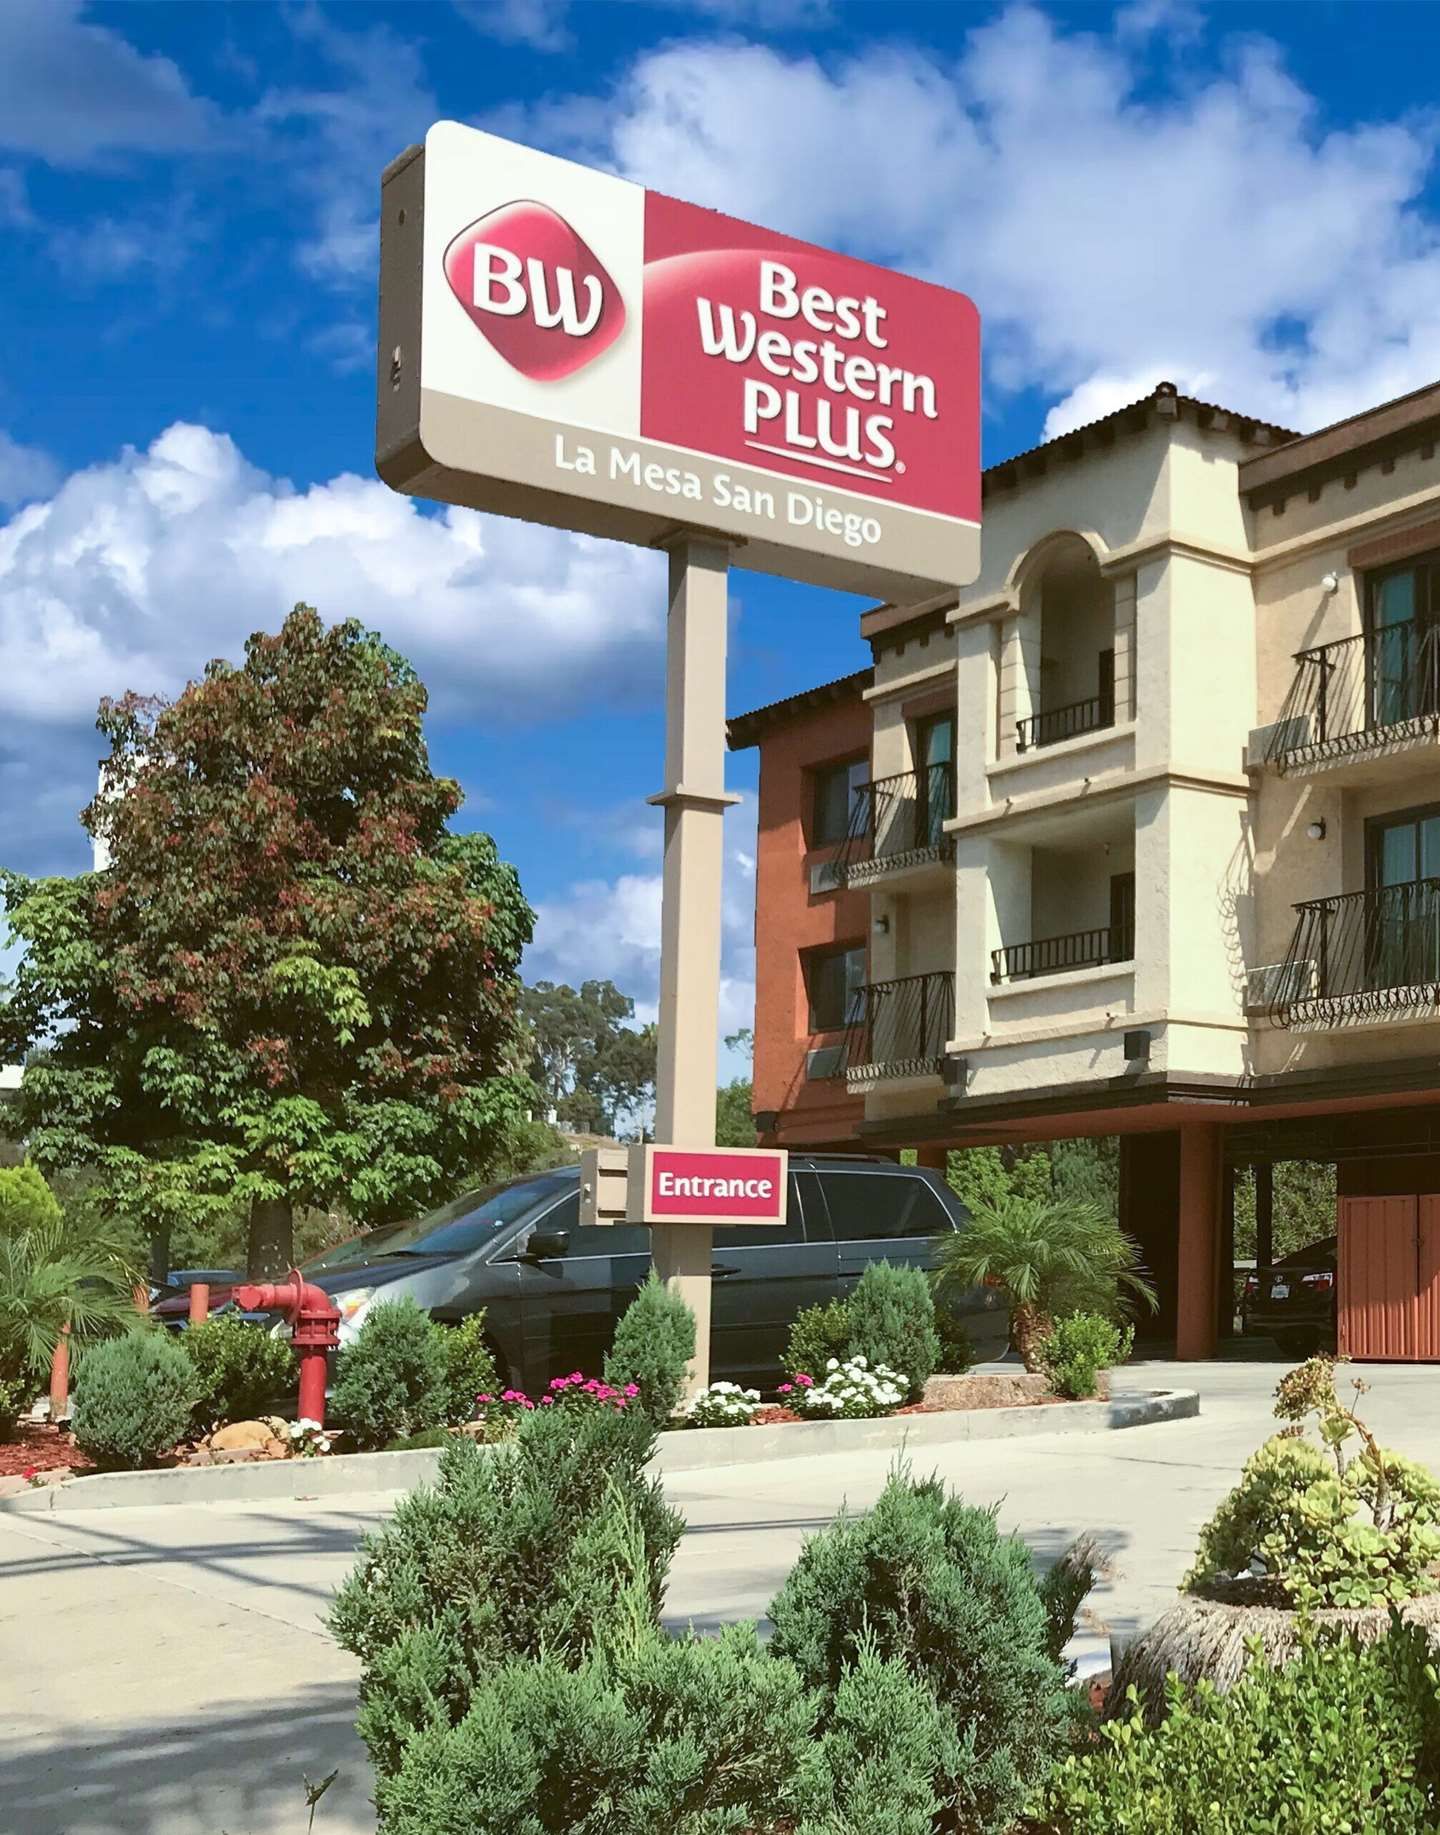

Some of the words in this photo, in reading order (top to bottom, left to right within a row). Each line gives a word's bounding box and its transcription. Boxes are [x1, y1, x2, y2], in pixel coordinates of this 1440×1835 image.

[473, 242, 603, 338] BW
[760, 259, 888, 348] Best
[696, 296, 938, 418] Western
[743, 377, 896, 468] PLUS
[554, 433, 597, 475] La
[608, 447, 703, 501] Mesa
[713, 474, 776, 519] San
[786, 491, 882, 547] Diego
[657, 1171, 773, 1199] Entrance
